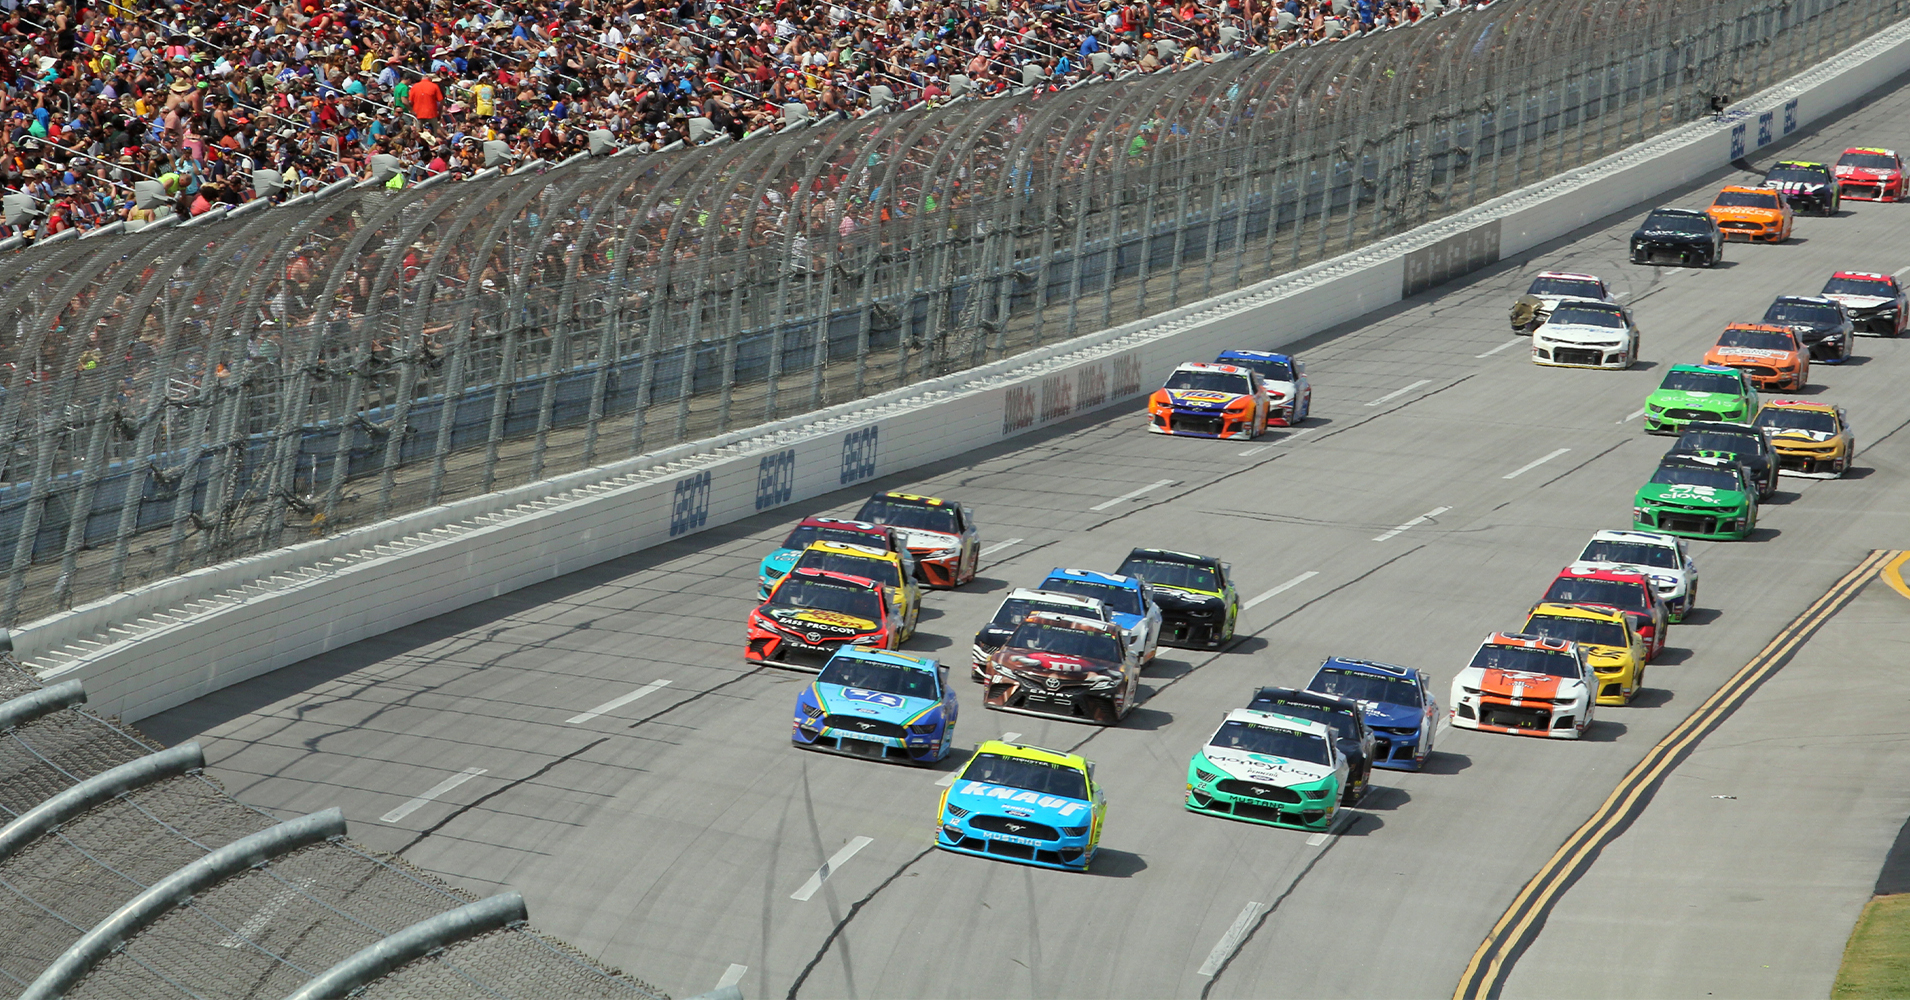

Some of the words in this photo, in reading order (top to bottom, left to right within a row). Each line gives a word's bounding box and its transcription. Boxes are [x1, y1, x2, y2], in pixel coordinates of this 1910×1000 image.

[1660, 396, 1732, 407] acorns
[840, 425, 878, 485] GEICO
[755, 449, 795, 510] GEICO
[670, 470, 711, 537] GEICO
[1659, 491, 1721, 505] clover
[779, 617, 804, 626] BASS
[806, 622, 856, 635] PRO.COM
[1029, 688, 1074, 698] CAMRY
[805, 717, 816, 726] 17
[834, 730, 890, 744] MUSTANG
[1208, 755, 1322, 780] MoneyLion
[960, 781, 1088, 817] KNAUF
[1229, 795, 1285, 809] MUSTANG
[950, 817, 961, 826] 12
[983, 832, 1042, 847] MUSTANG
